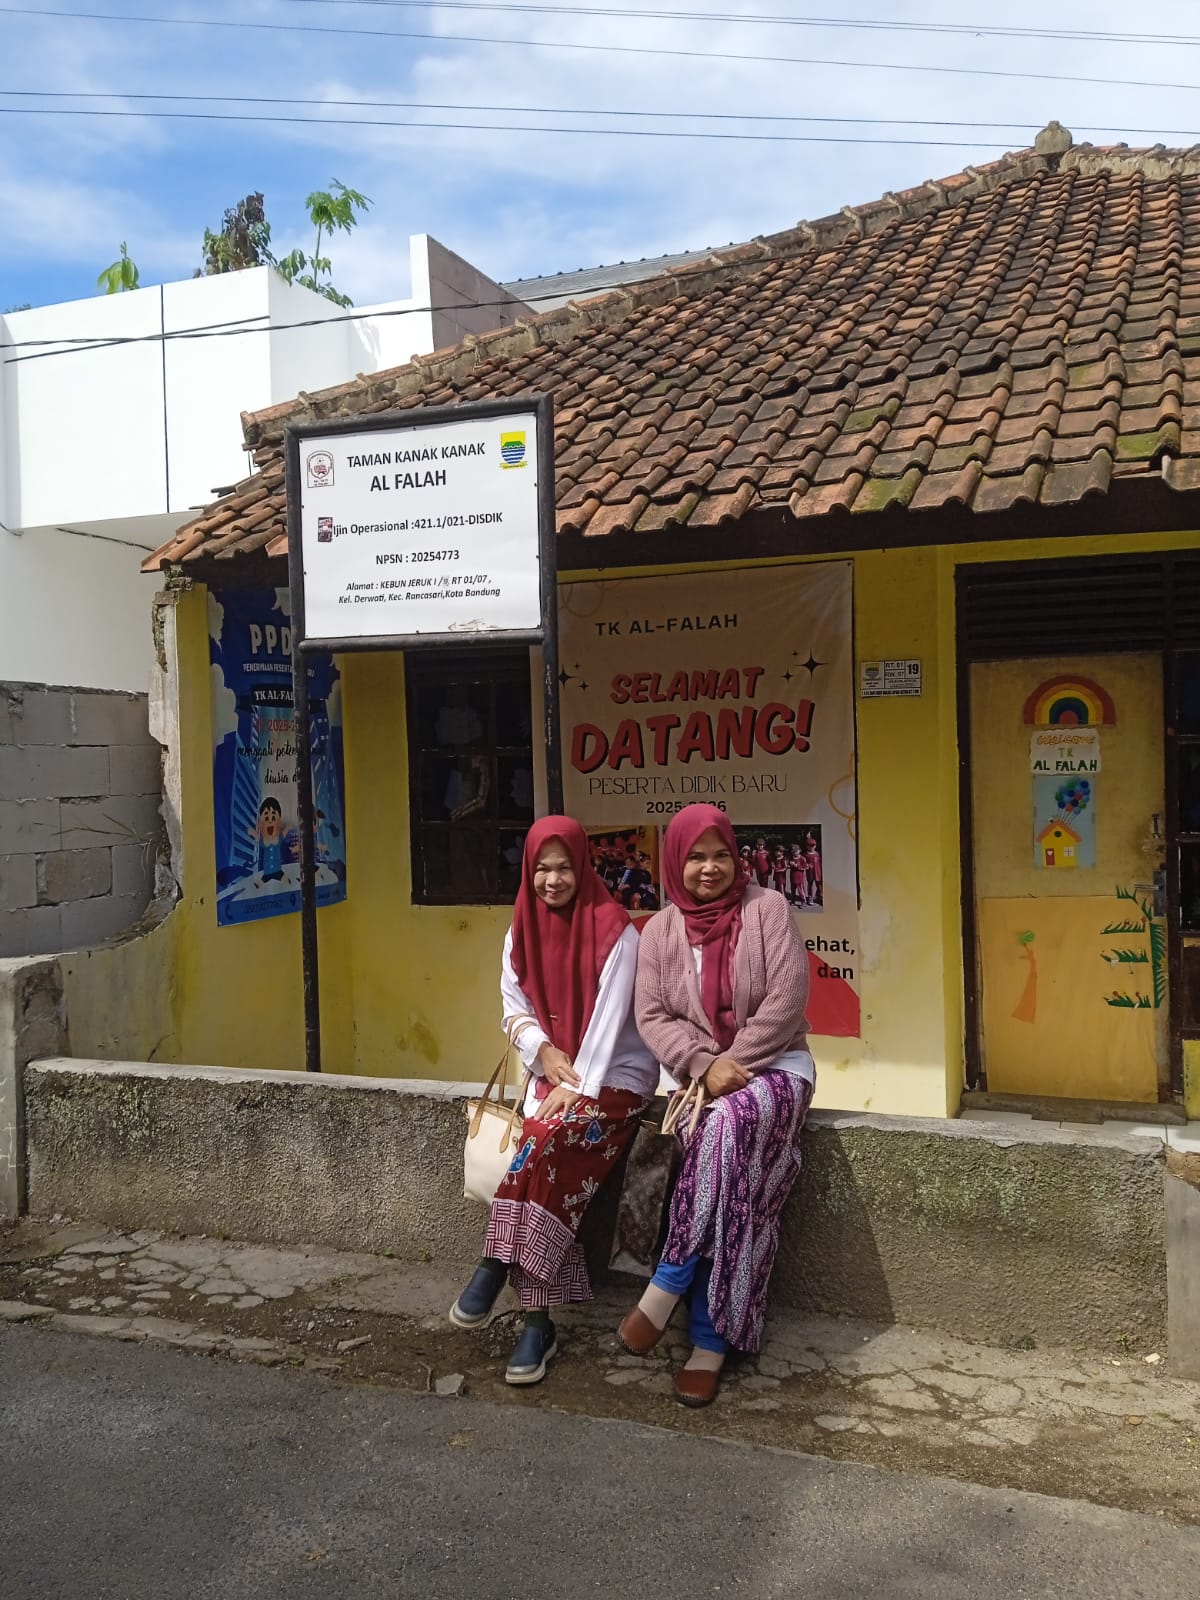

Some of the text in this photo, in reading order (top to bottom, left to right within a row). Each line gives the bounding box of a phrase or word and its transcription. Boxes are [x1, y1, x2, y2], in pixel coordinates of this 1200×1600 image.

[347, 442, 486, 468] TAMAN KANAK KANAK
[370, 469, 447, 492] AL FALAH
[333, 511, 503, 537] Ijin Operasional :421.1/021-DISDIK
[376, 553, 403, 565] NPSN
[411, 550, 460, 563] 20254773
[346, 582, 374, 591] Alamat
[380, 579, 407, 589] KEBUN
[408, 577, 432, 588] JERUK
[451, 576, 462, 585] RT
[463, 574, 488, 585] 01/07
[338, 595, 352, 604] Kel.
[354, 594, 386, 603] Derwati,
[388, 593, 403, 601] Kec.
[465, 587, 501, 597] Bandung
[595, 613, 738, 636] TK AL-FALAH
[249, 623, 293, 656] PPD
[242, 663, 273, 673] PENERIMAAN
[906, 663, 919, 675] 19
[609, 666, 765, 705] SELAMAT
[254, 690, 267, 701] TK
[571, 699, 816, 775] DATANG!
[1058, 747, 1074, 758] TK
[1033, 759, 1098, 772] AL FALAH
[588, 773, 788, 796] PESERTA DIDIK BARU
[804, 935, 856, 956] ehat,
[817, 962, 854, 980] dan
